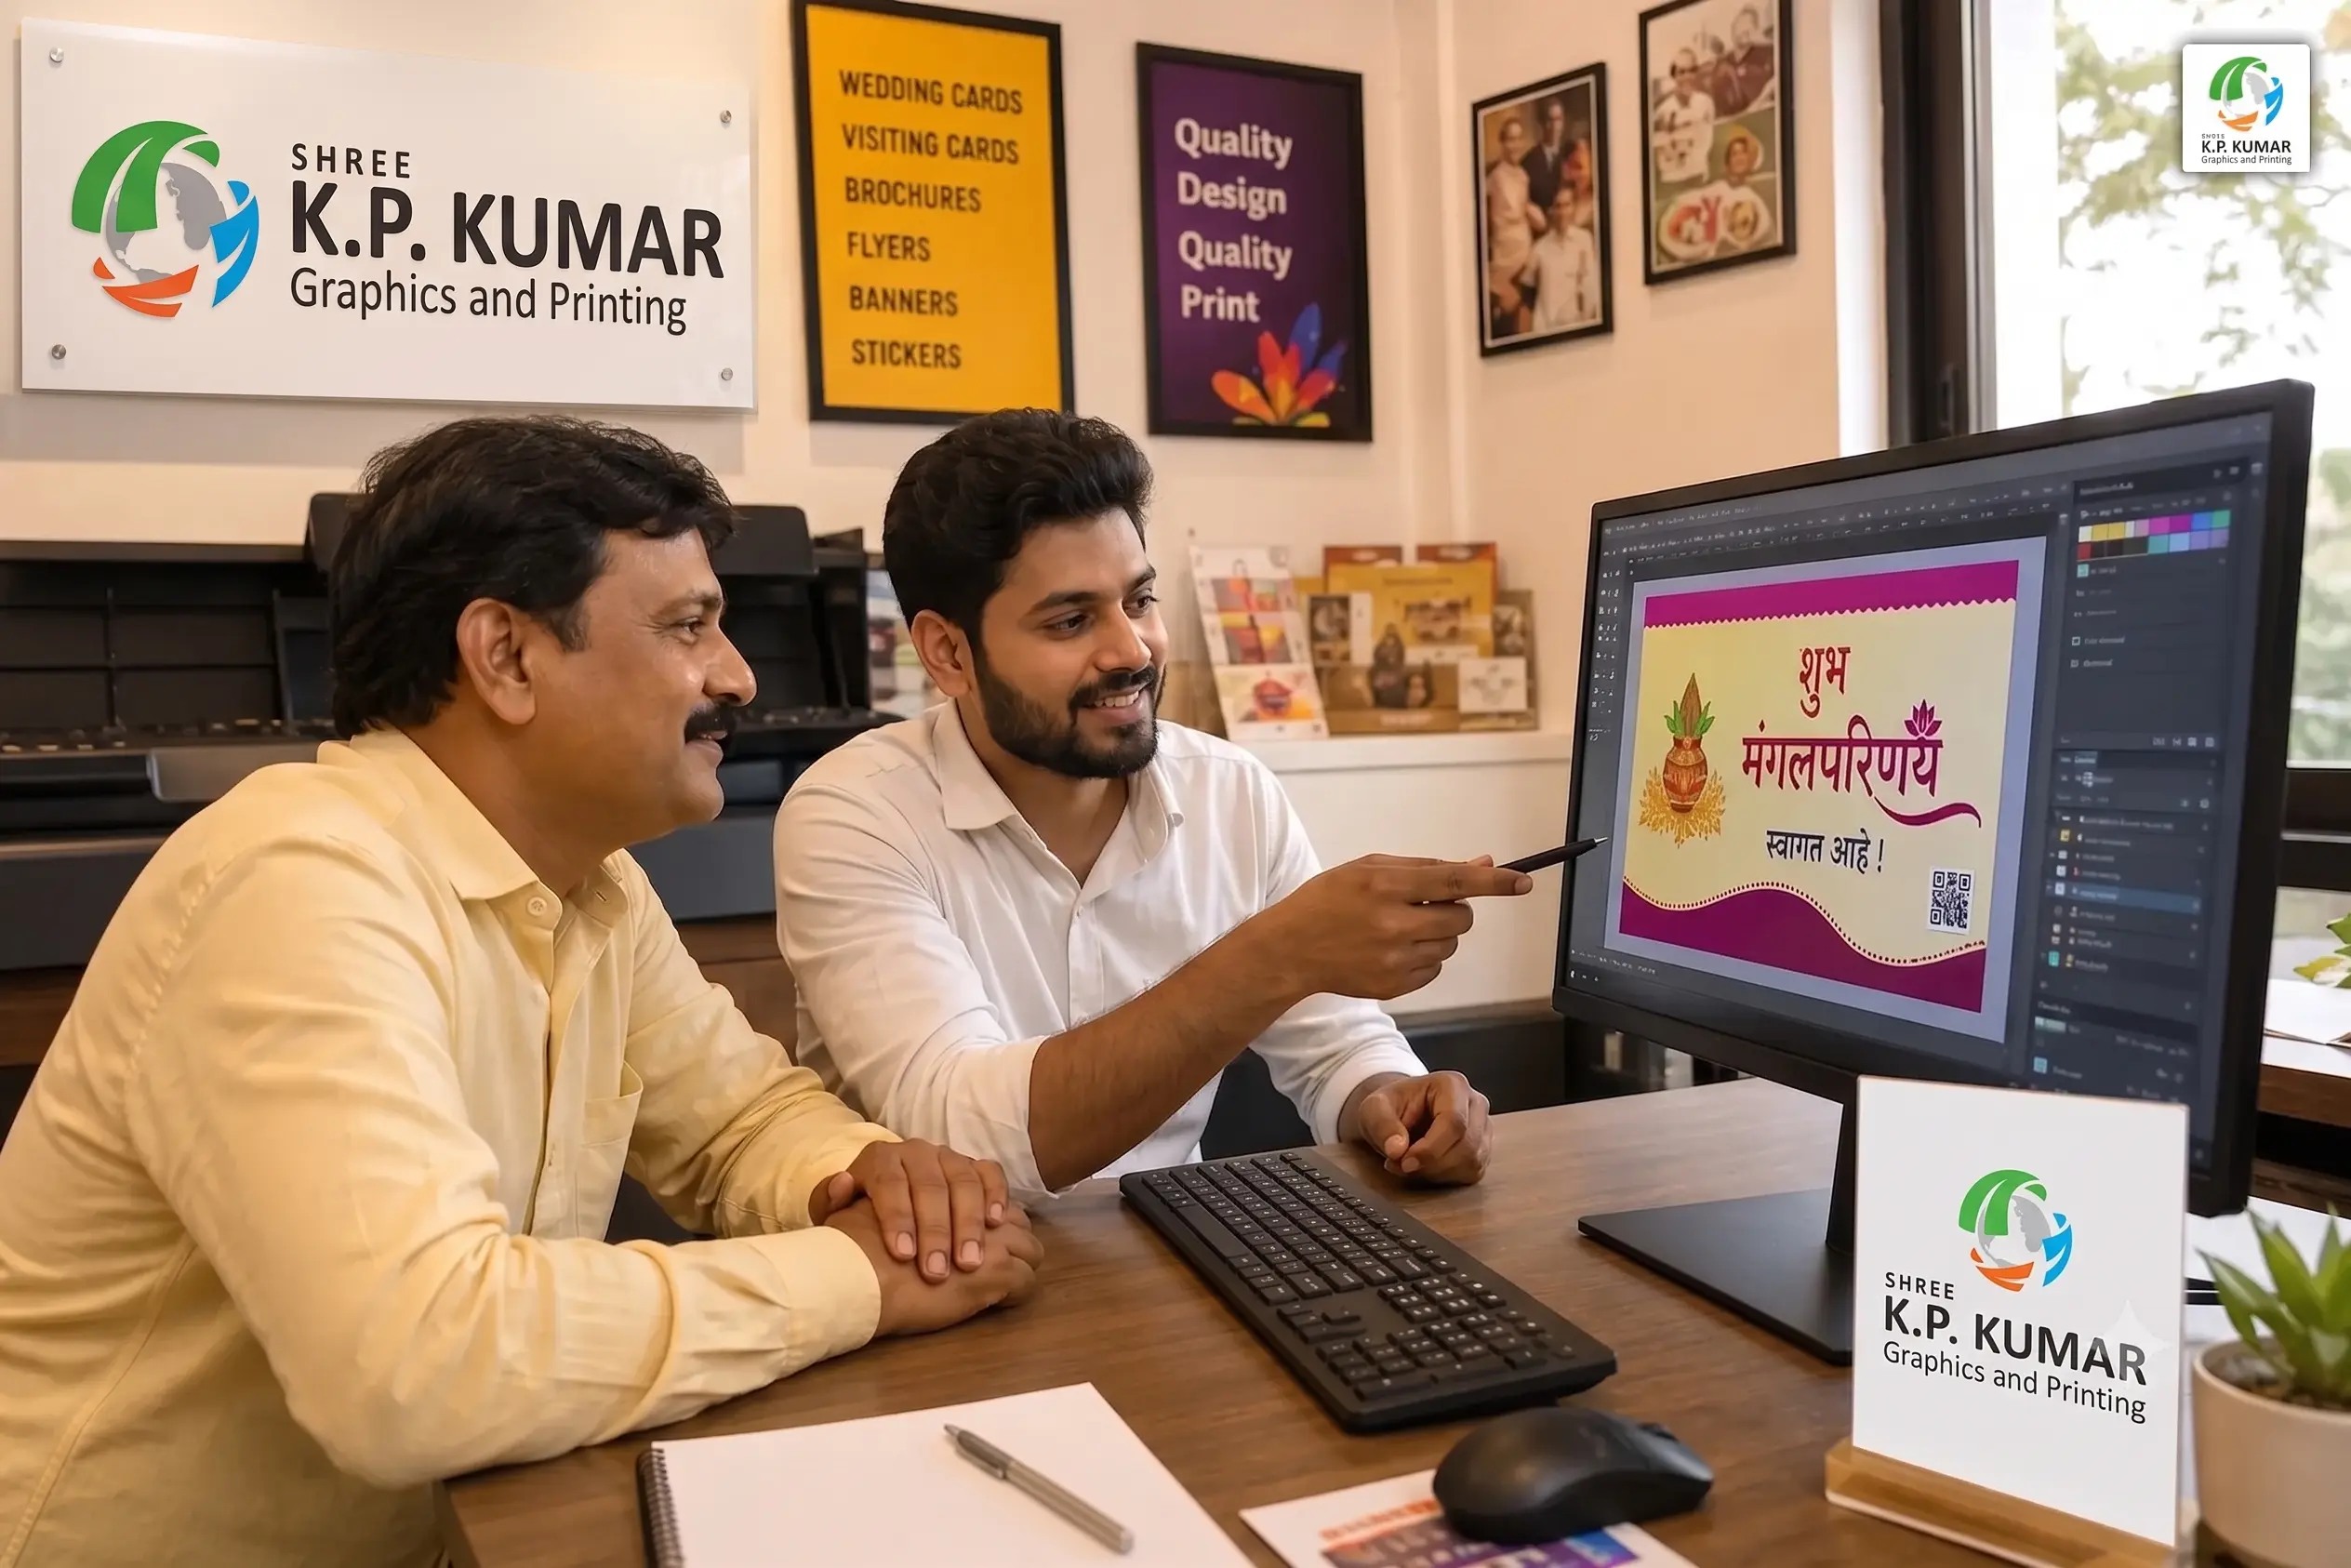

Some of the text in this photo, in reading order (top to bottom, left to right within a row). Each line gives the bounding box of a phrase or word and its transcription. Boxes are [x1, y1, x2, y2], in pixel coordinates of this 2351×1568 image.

[839, 71, 1023, 114] WEDDING CARDS
[291, 143, 411, 179] SHREE
[842, 124, 1019, 165] VISITING CARDS
[1175, 118, 1293, 169] Quality
[844, 178, 981, 213] BROCHURES
[1177, 172, 1287, 220] Design
[291, 180, 724, 279] K.P. KUMAR
[847, 233, 930, 262] FLYERS
[1178, 232, 1293, 280] Quality
[289, 268, 686, 336] Graphics and Printing
[850, 286, 958, 317] BANNERS
[1181, 285, 1260, 323] Print
[852, 339, 962, 369] STICKERS
[1800, 645, 1851, 718] शुभ
[1766, 830, 1826, 864] स्वागत
[1829, 828, 1871, 874] आहे
[1885, 1271, 1955, 1300] SHREE
[1885, 1295, 2147, 1386] K.P. KUMAR
[1883, 1341, 2146, 1425] Graphics and Printing
